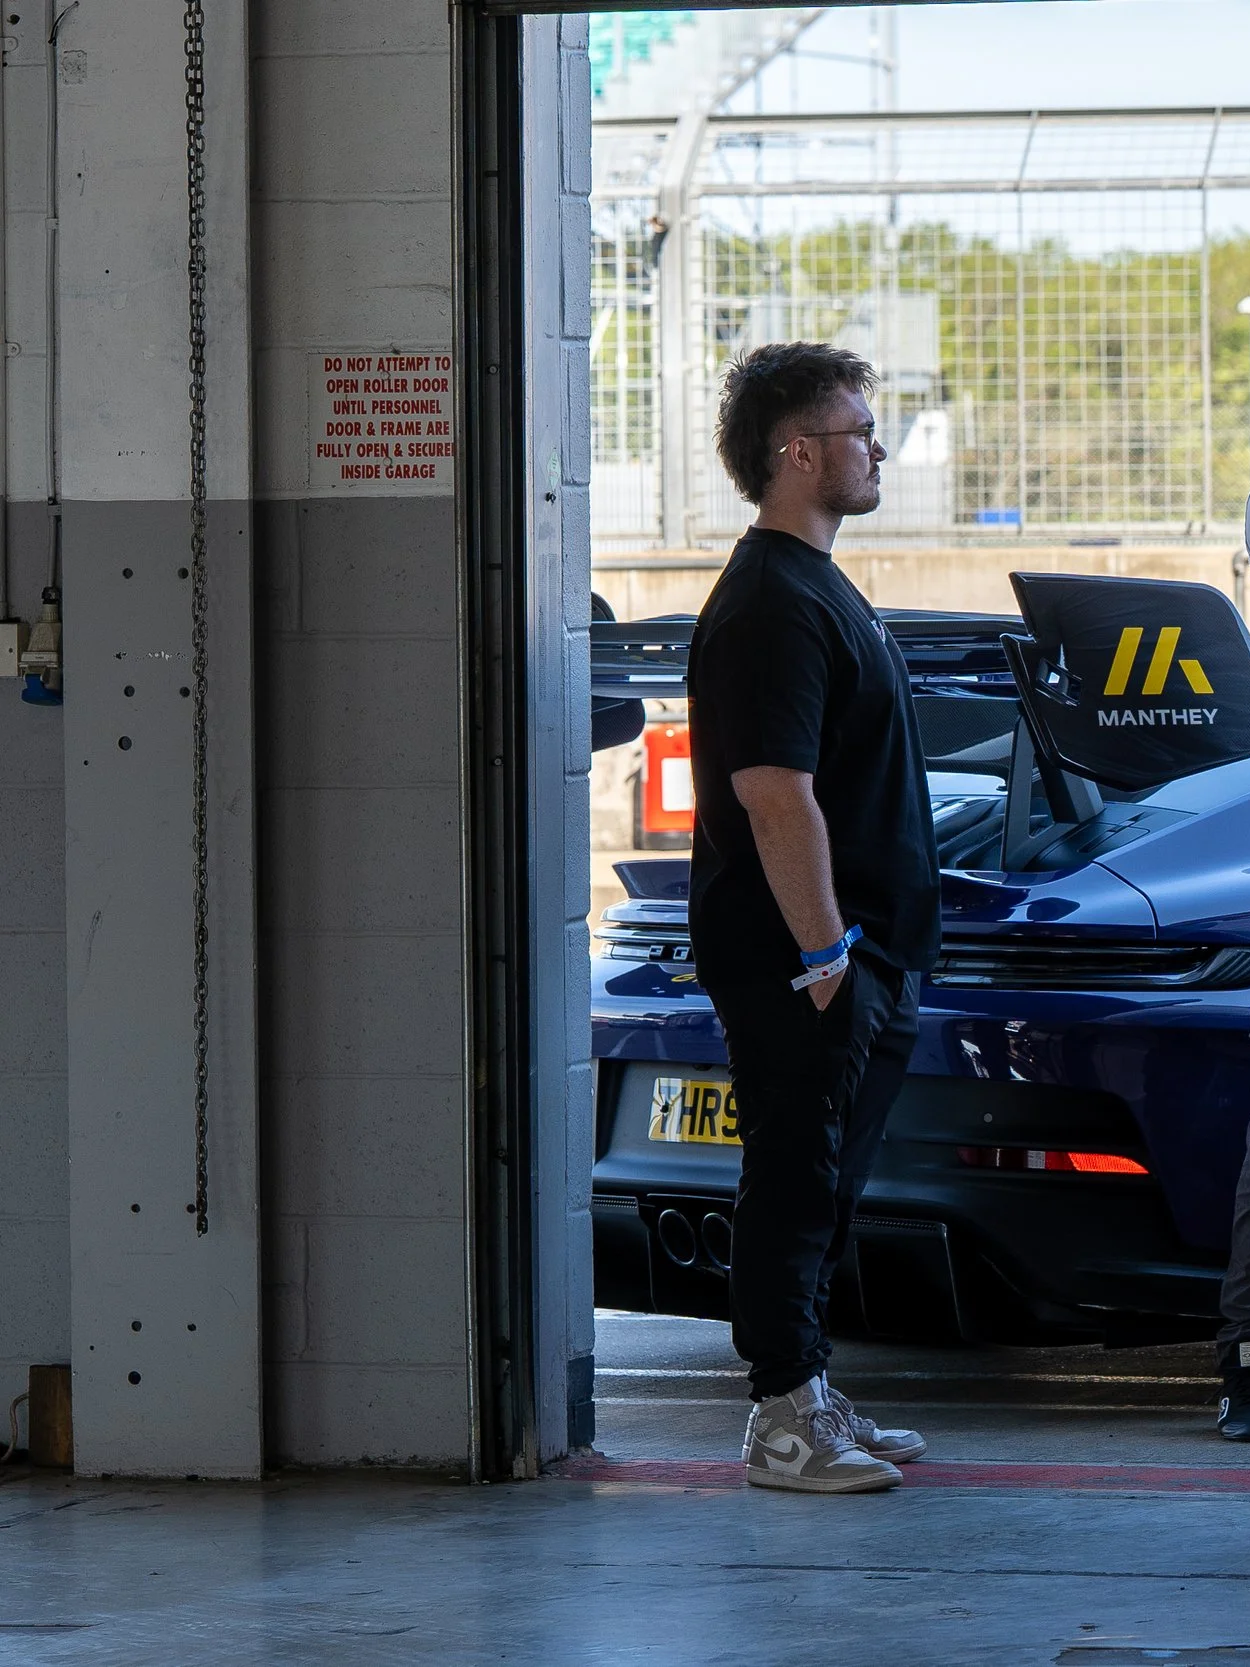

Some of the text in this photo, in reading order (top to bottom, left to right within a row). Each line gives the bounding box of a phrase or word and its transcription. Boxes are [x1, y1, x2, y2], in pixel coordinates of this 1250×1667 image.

[324, 356, 451, 372] DO NOT ATTEMPT TO
[326, 378, 449, 393] OPEN ROLLER DOOR
[333, 399, 442, 415] UNTIL PERSONNEL
[326, 420, 450, 436] DOOR & FRAME ARE
[316, 443, 352, 458] FULLY
[356, 443, 389, 458] OPEN
[393, 443, 403, 457] &
[341, 464, 436, 479] INSIDE GARAGE
[1098, 708, 1218, 727] MANTHEY
